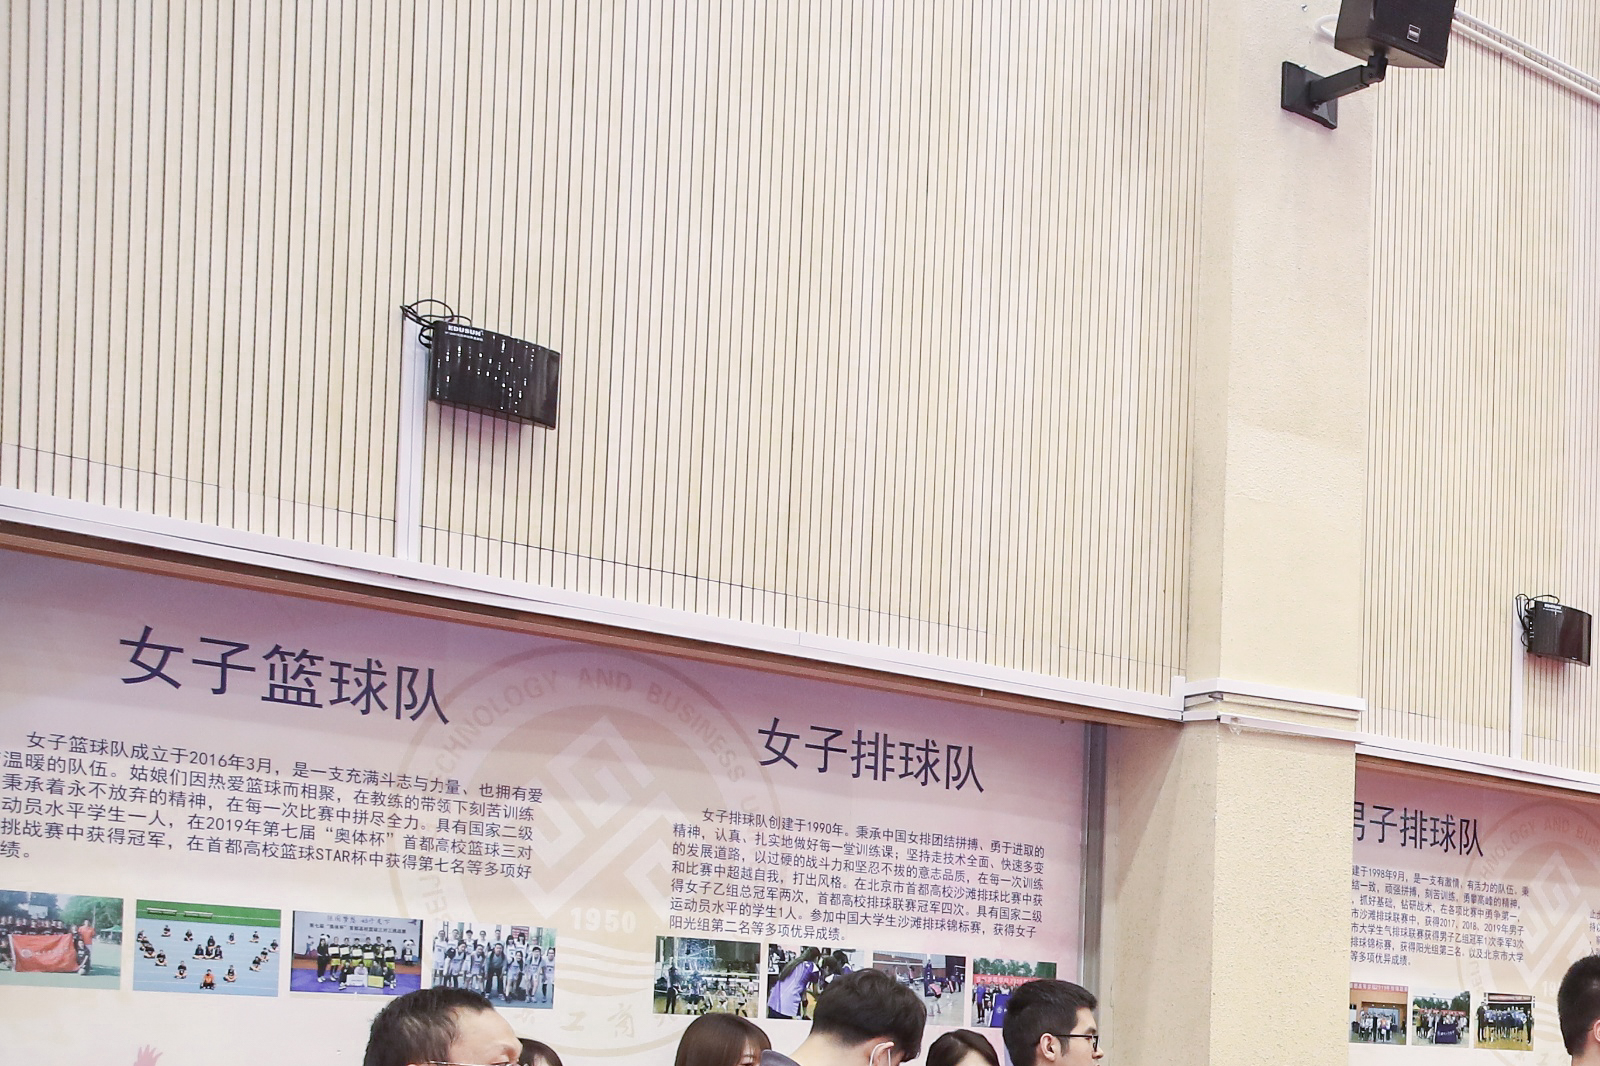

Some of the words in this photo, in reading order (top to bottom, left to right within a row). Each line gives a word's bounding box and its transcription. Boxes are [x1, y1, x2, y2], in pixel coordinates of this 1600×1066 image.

[119, 625, 451, 724] 女子篮球队
[577, 666, 632, 694] AND
[757, 717, 985, 793] 女子排球队
[1, 773, 534, 842] 秉承着永不放弃的精神，在每一次比赛中拼尽全力。具有国家二级
[570, 907, 637, 934] 1950
[669, 915, 847, 942] 阳光组第二名等多项优异成绩。
